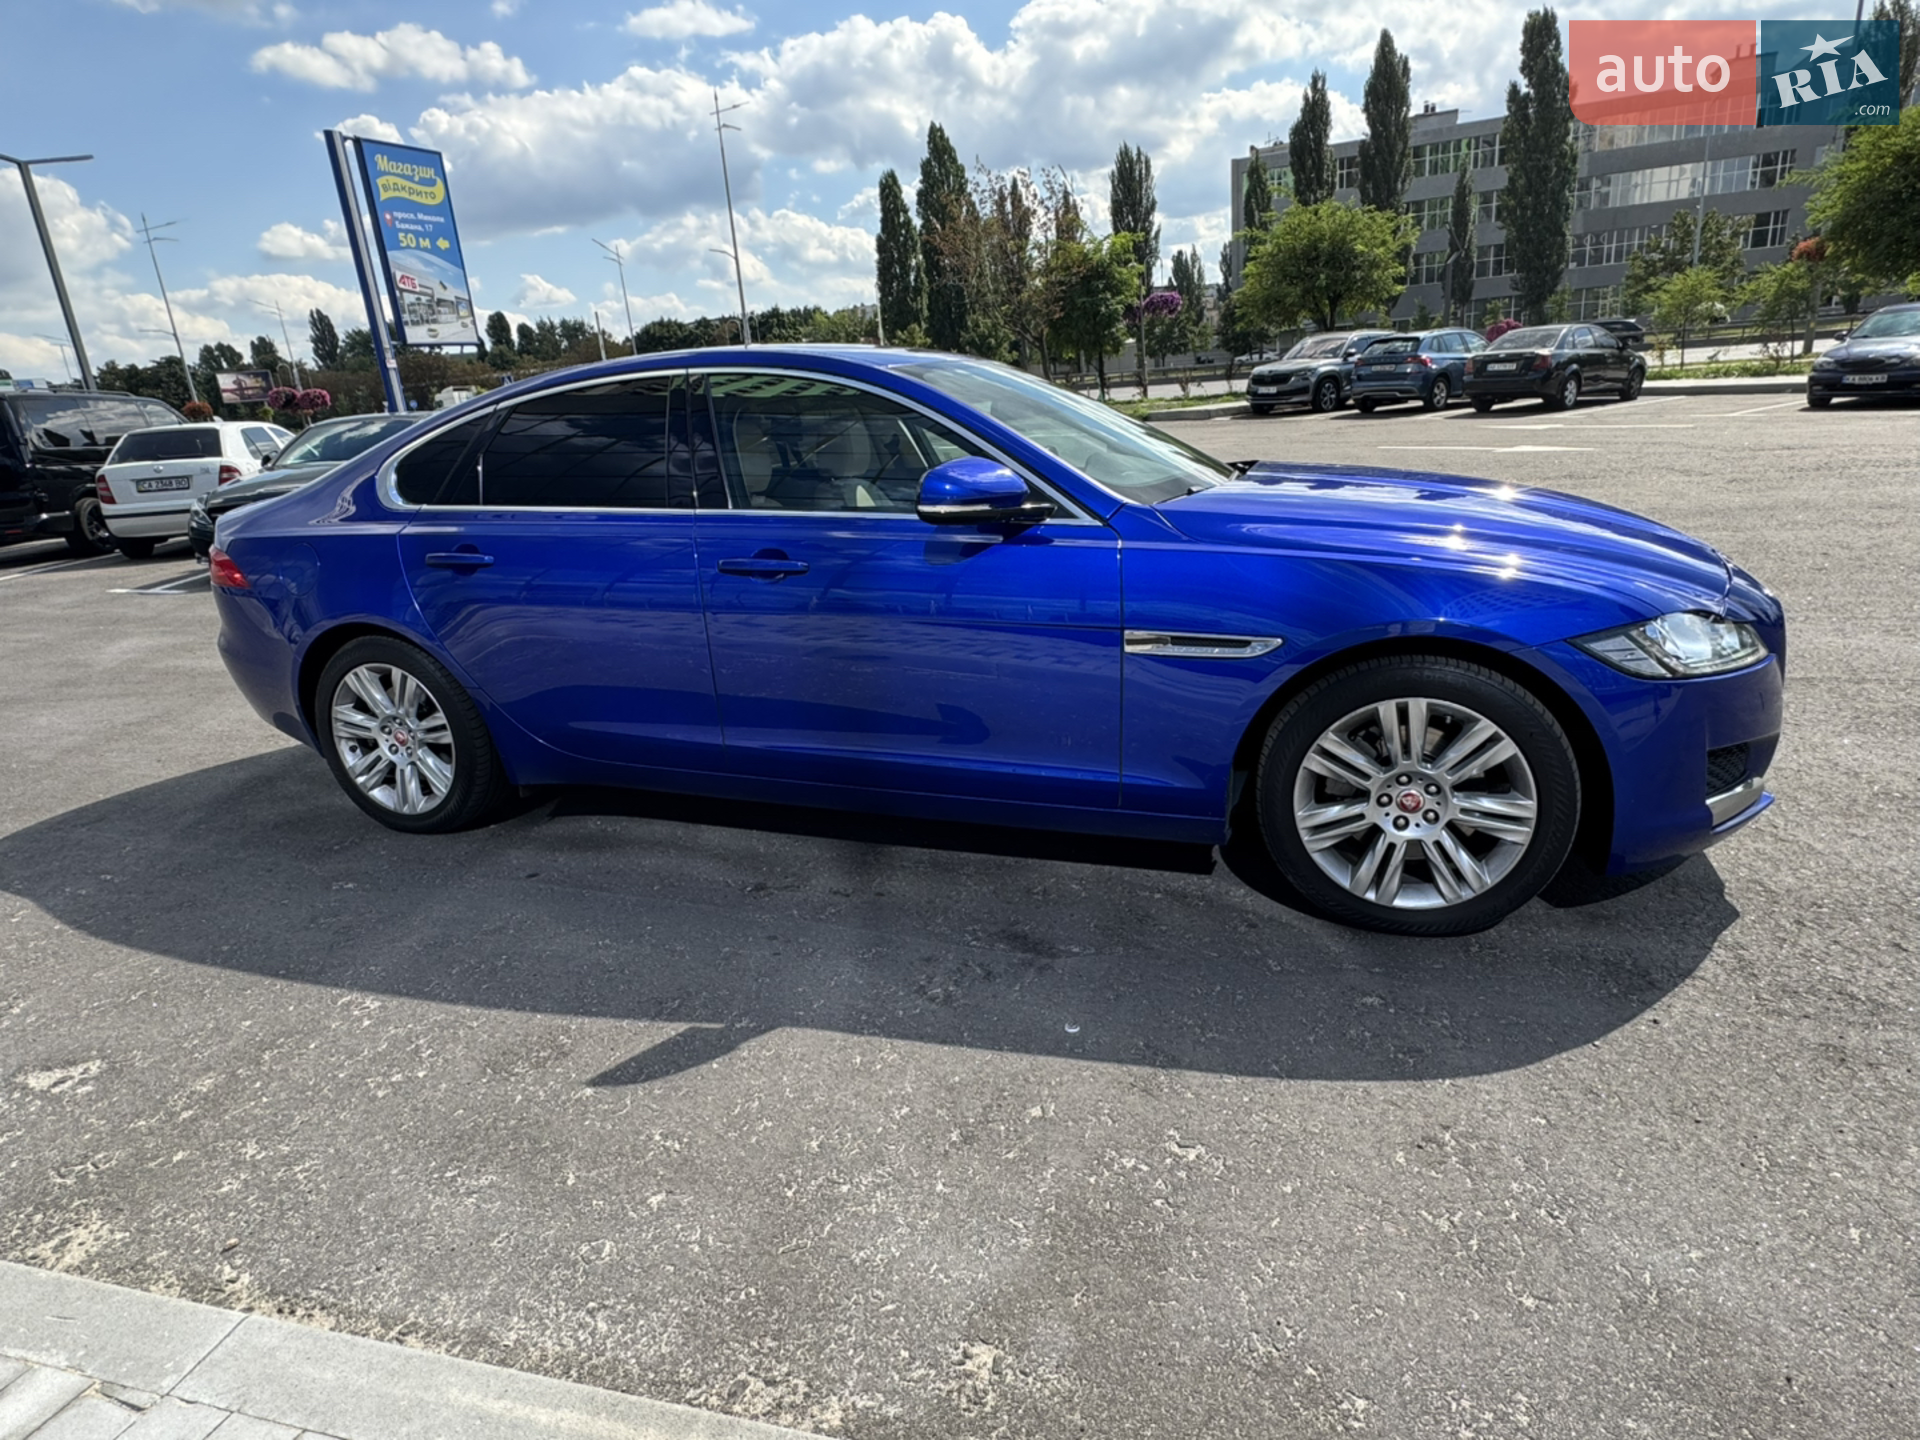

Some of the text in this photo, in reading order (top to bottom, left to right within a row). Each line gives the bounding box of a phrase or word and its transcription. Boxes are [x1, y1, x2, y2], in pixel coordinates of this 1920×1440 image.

[374, 154, 437, 182] Магазин
[381, 179, 437, 200] відкрито
[425, 223, 433, 232] 17
[398, 232, 417, 249] 50
[399, 274, 417, 289] АТБ
[142, 481, 153, 490] CA
